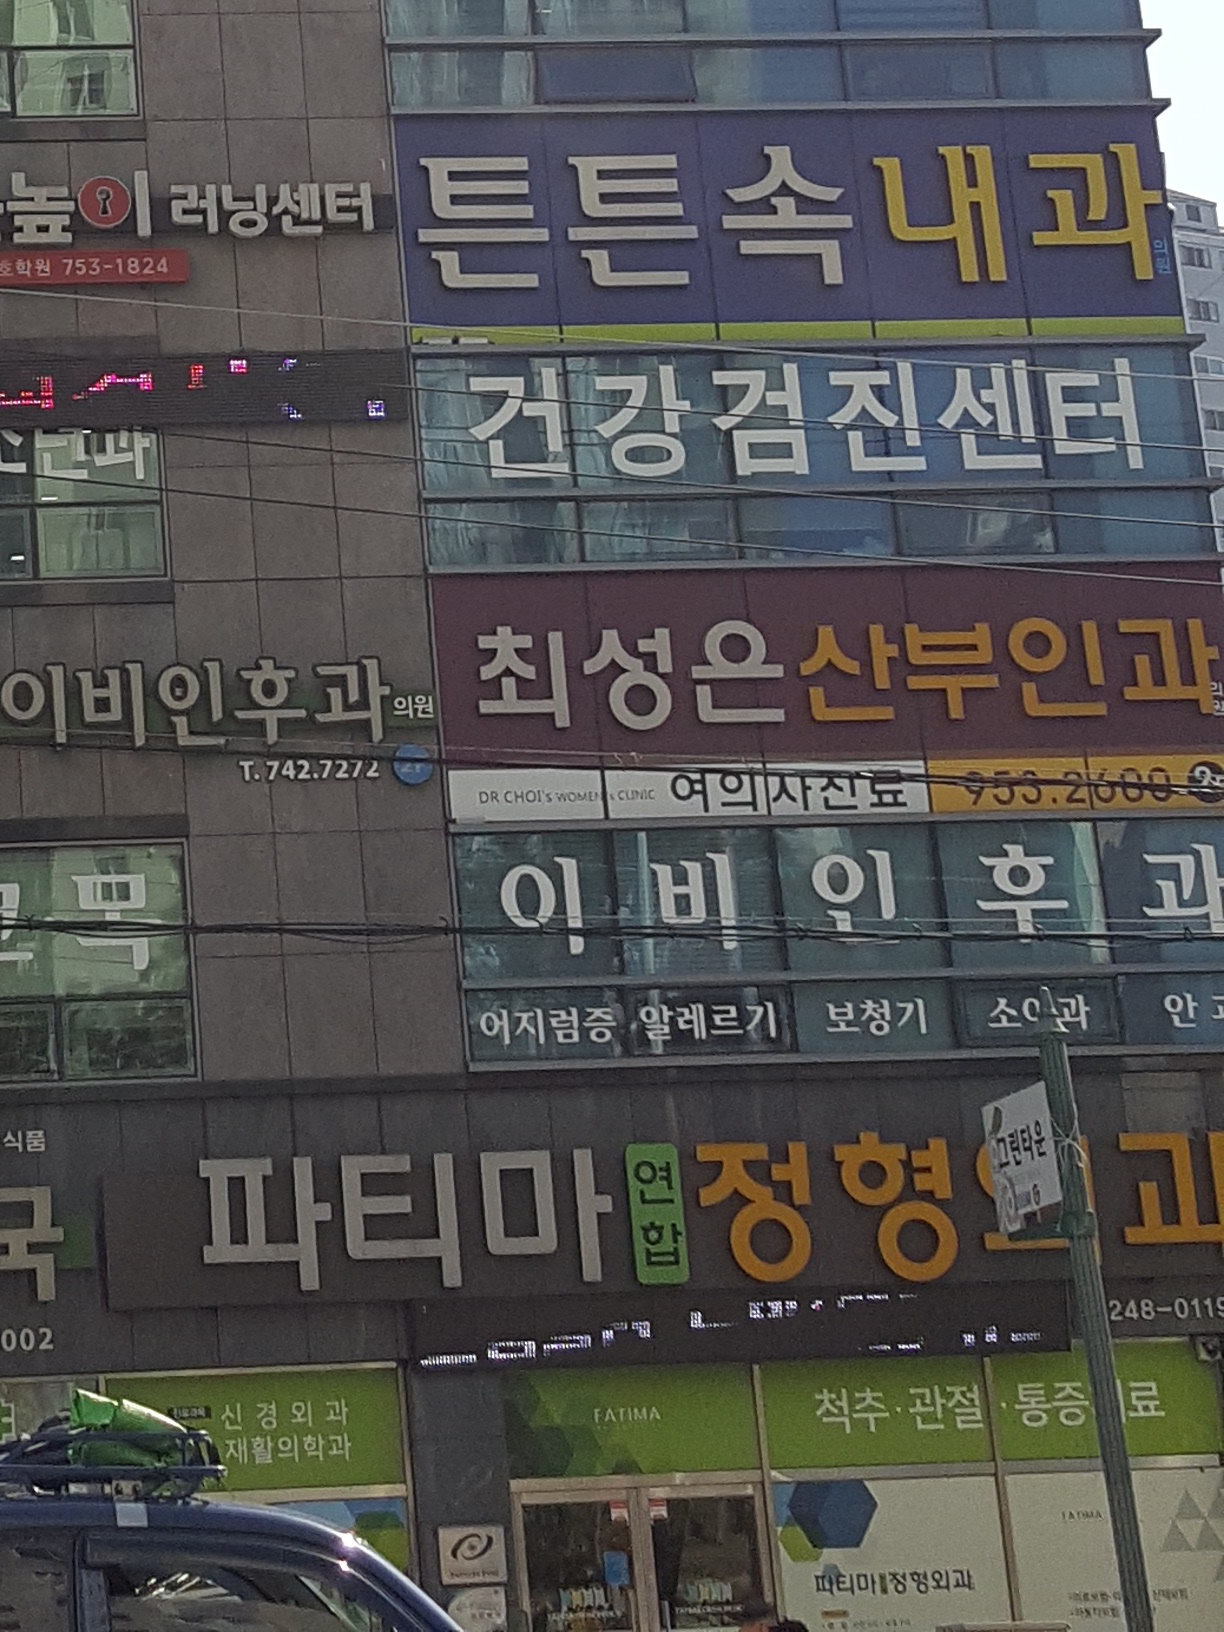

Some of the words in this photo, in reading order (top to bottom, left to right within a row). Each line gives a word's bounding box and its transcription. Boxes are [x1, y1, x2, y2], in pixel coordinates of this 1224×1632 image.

[170, 181, 374, 238] 러닝센터
[417, 143, 1164, 290] 튼튼속내과
[62, 254, 169, 277] 753-1824
[468, 357, 1144, 480] 건강검진센터
[476, 616, 1221, 730] 최성은산부인과
[392, 694, 435, 719] 의원
[478, 789, 500, 806] DR
[504, 788, 553, 805] CHOI's
[480, 1005, 619, 1046] 어지럼증
[639, 998, 777, 1041] 알레르기
[825, 993, 928, 1036] 보청기
[996, 1119, 1047, 1169] 그린타운
[198, 1148, 613, 1292] 파티마
[634, 1159, 682, 1267] 연합
[593, 1405, 662, 1424] FATIMA
[225, 1432, 352, 1465] 재활의학과
[813, 1572, 877, 1596] 파티마
[888, 1569, 976, 1595] 정형외과
